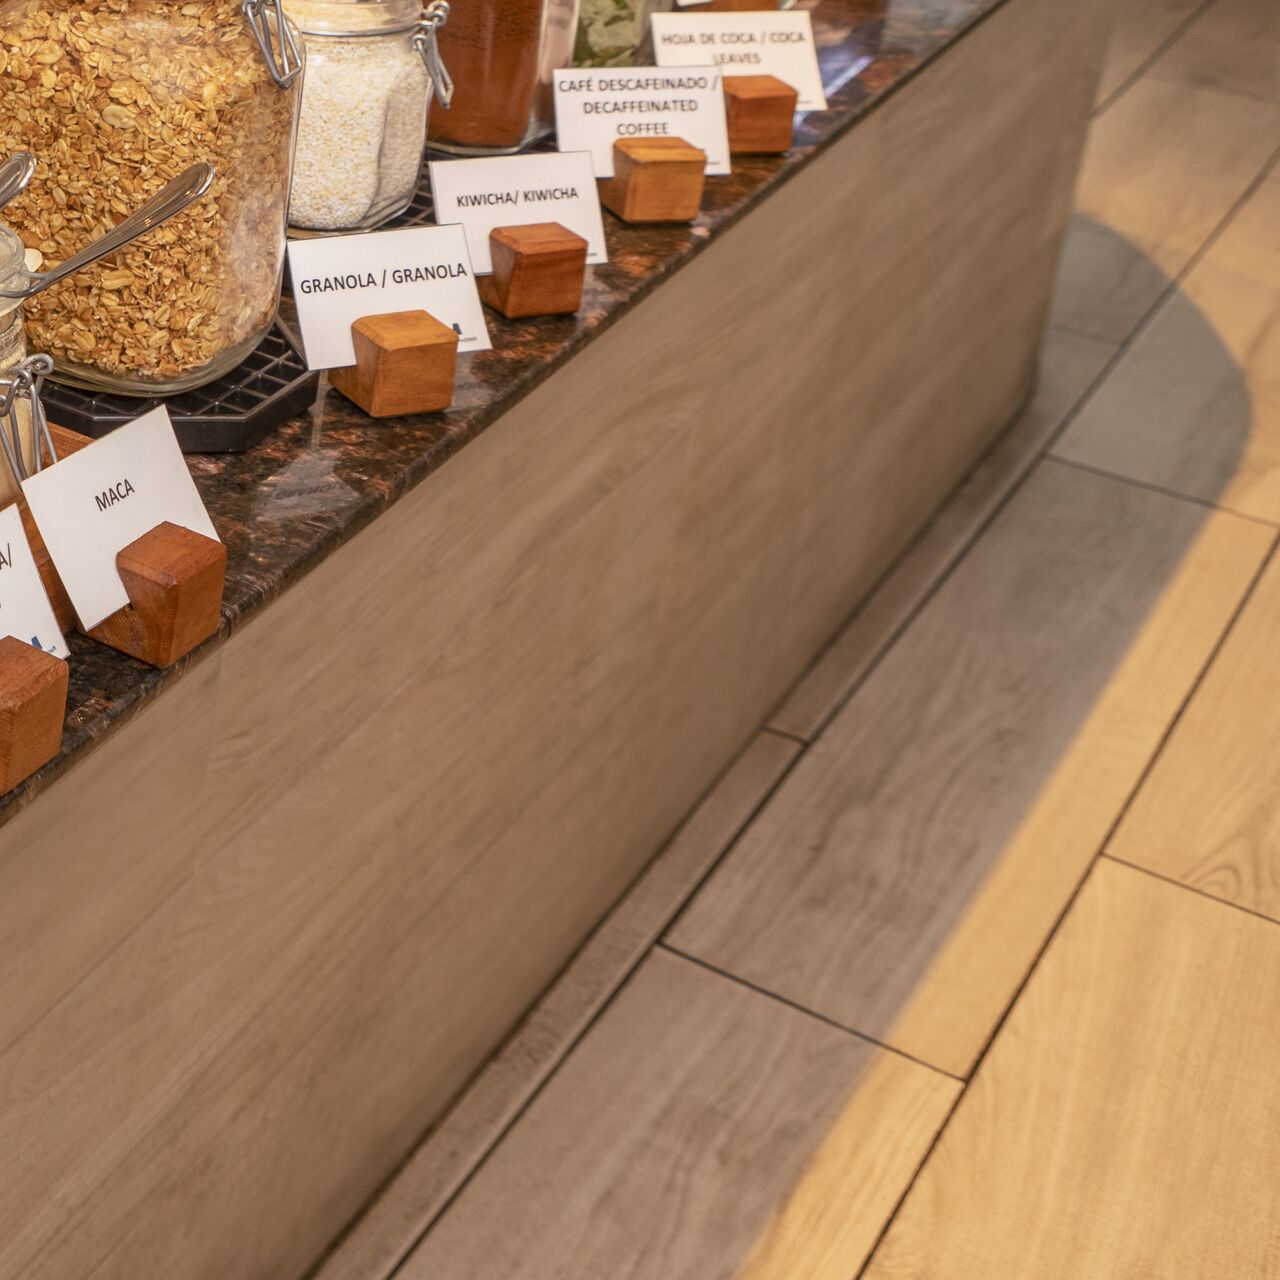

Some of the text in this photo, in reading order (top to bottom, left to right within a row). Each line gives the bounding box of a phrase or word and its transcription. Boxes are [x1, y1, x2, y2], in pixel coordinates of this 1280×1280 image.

[662, 34, 695, 45] HOJA
[700, 33, 715, 44] DE
[722, 32, 756, 44] COCA
[770, 31, 806, 43] COCA
[713, 53, 761, 65] LEAVES
[559, 77, 593, 93] CAFÉ
[598, 77, 708, 92] DESCAFEINADO
[583, 99, 698, 114] DECAFFEINATED
[617, 122, 669, 136] COFFEE
[456, 187, 579, 208] KIWICHA/ KIWICHA
[300, 263, 468, 295] GRANOLA / GRANOLA
[95, 478, 135, 512] MACA
